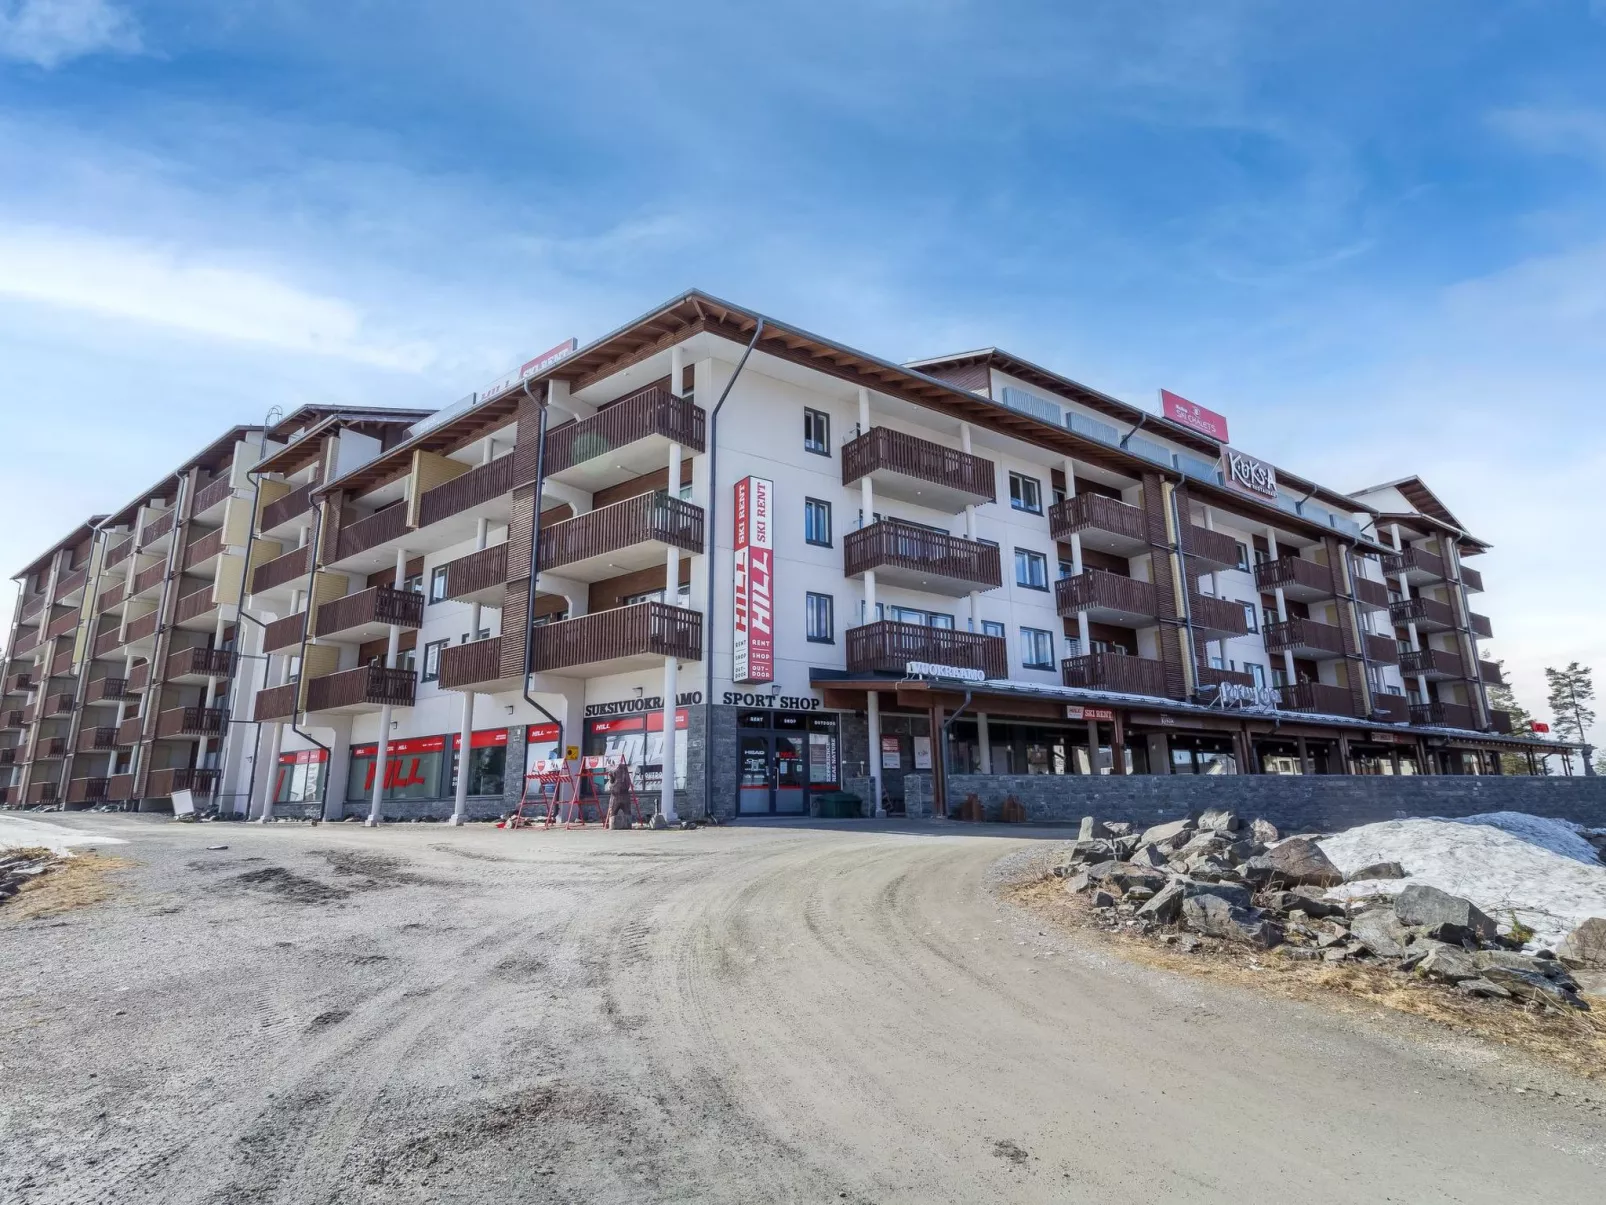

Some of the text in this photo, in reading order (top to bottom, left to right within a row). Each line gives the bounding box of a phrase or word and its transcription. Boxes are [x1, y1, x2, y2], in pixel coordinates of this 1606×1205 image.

[757, 482, 766, 543] SKI RENT
[736, 551, 746, 632] HILL
[752, 552, 770, 634] HILL
[752, 639, 770, 647] RENT
[723, 692, 820, 710] SPORT SHOP
[1084, 709, 1095, 717] SKI
[1096, 710, 1112, 719] RENT
